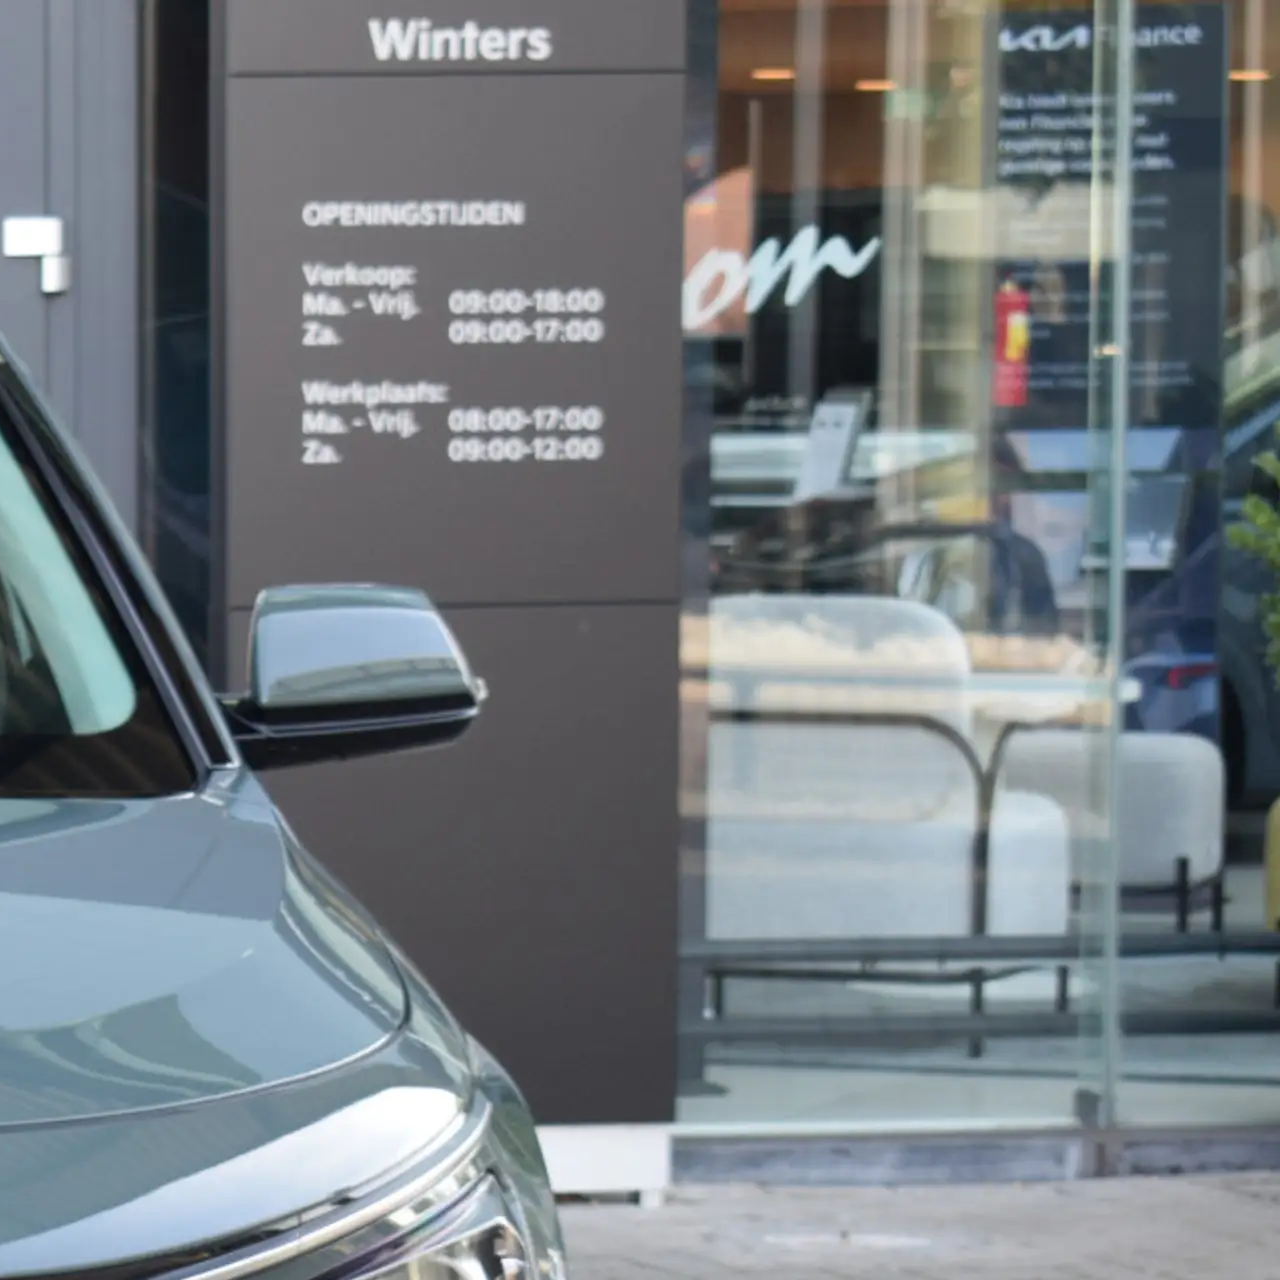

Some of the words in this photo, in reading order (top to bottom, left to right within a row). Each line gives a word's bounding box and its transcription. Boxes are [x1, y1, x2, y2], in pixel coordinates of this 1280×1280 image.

[368, 17, 553, 61] Winters
[301, 201, 526, 226] OPENINGSTIJDEN
[302, 262, 417, 289] Verkoop:
[302, 292, 349, 315] Ma.
[302, 321, 343, 345] Za.
[448, 317, 604, 343] 09:00-17:00
[302, 380, 450, 408] Werkplaats:
[302, 408, 349, 433] Ma.
[302, 438, 343, 463] Za.
[448, 435, 604, 461] 09:00-12:00
